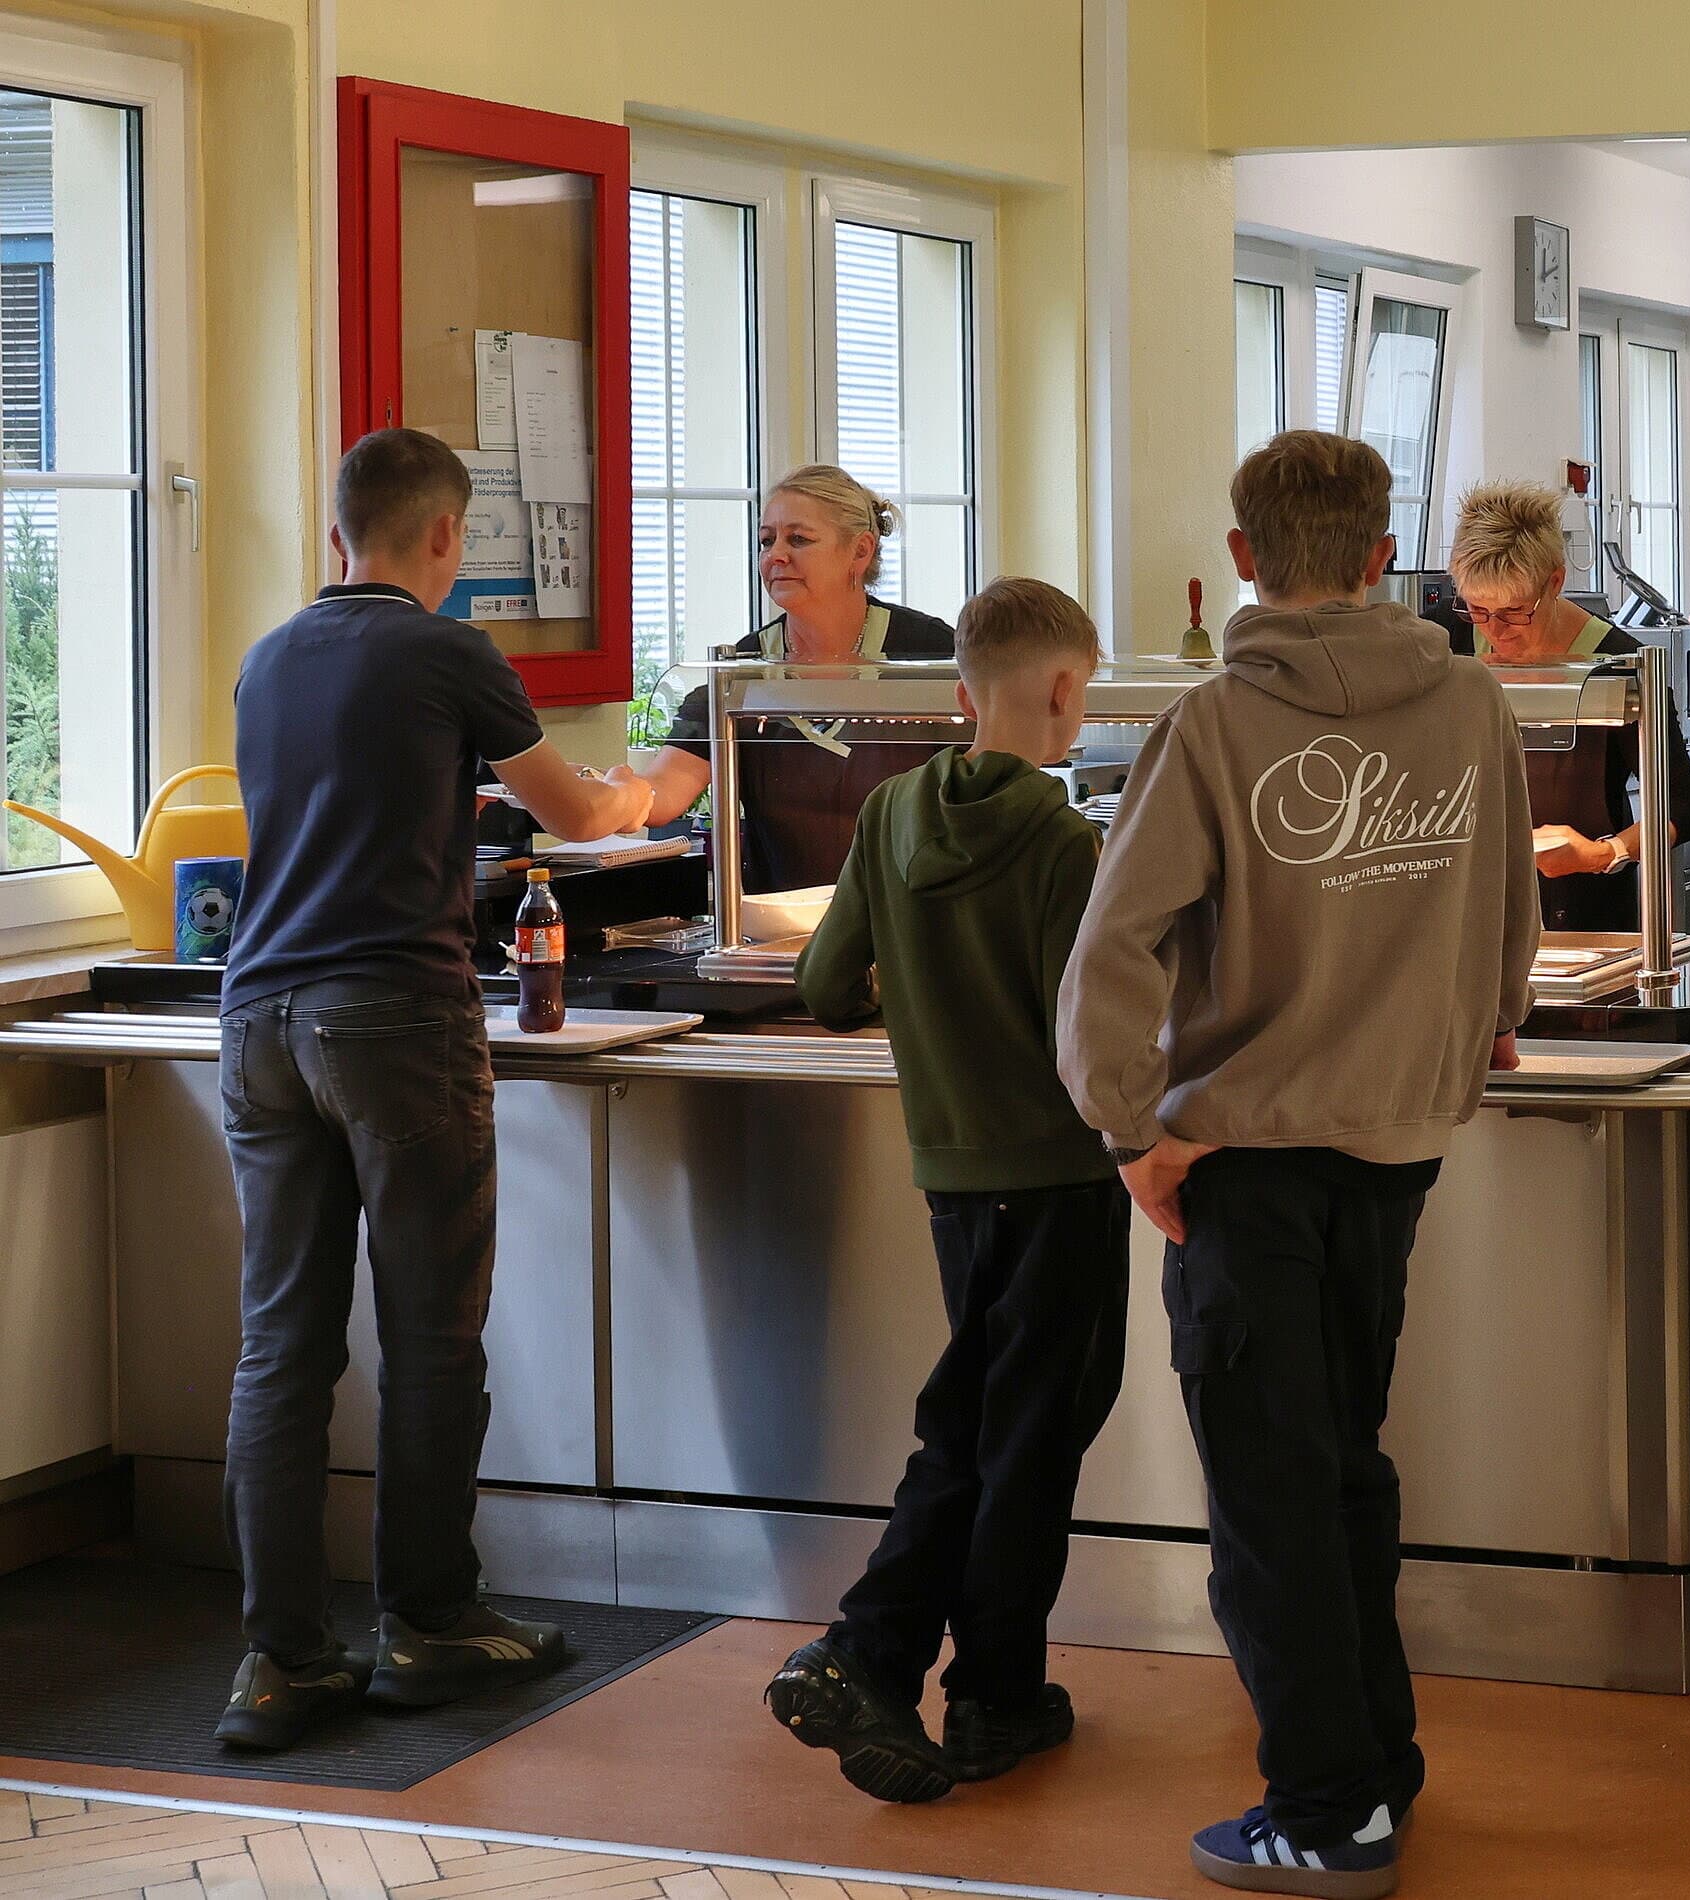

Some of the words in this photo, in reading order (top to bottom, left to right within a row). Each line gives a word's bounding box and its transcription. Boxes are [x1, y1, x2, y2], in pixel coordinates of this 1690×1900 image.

[1321, 870, 1360, 889] FOLLOW
[1361, 865, 1382, 878] THE
[1382, 857, 1453, 874] MOVEMENT
[1408, 872, 1428, 880] 2012
